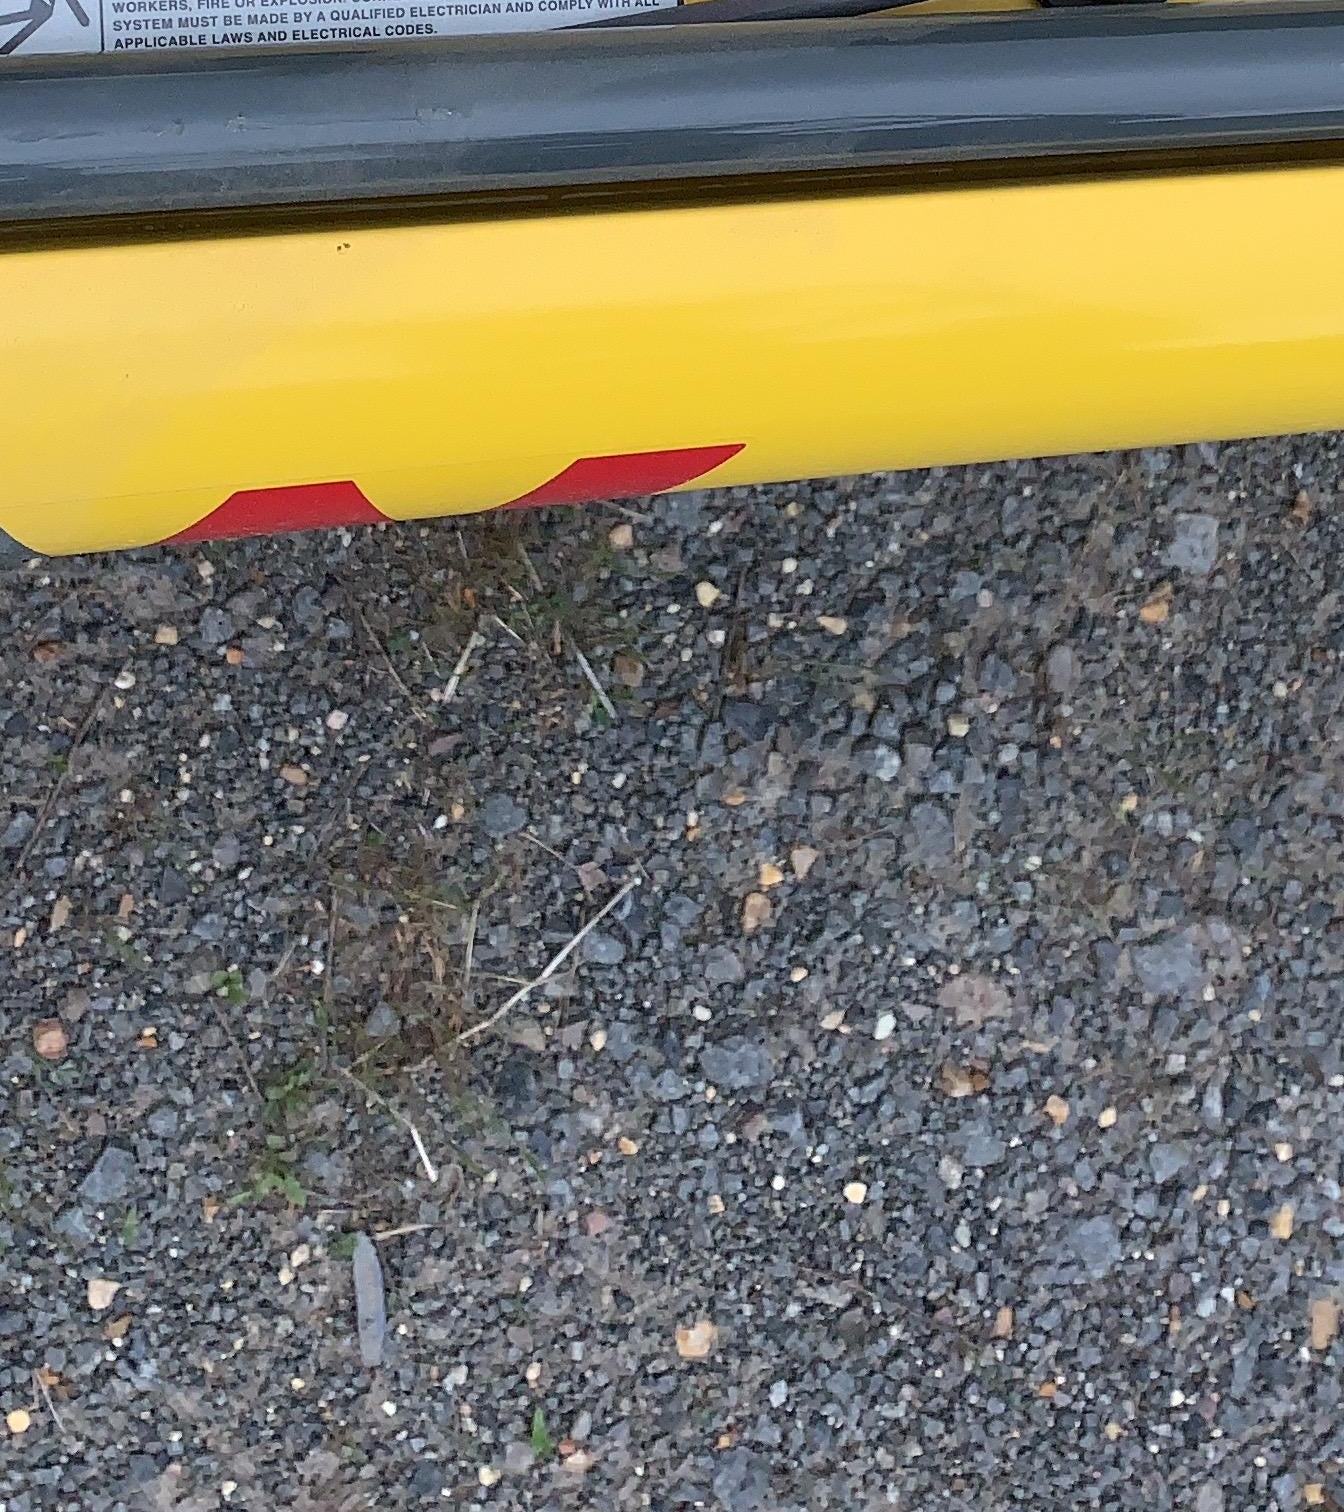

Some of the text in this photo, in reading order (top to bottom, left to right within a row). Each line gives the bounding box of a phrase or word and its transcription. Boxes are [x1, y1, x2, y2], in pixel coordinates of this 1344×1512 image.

[112, 0, 191, 14] WORKERS,
[112, 18, 172, 31] SYSTEM
[178, 16, 218, 28] MUST
[223, 15, 242, 26] BE
[247, 13, 288, 25] MADE
[293, 12, 311, 23] BY
[316, 11, 325, 22] A
[330, 8, 404, 22] QUALIFIED
[410, 3, 500, 18] ELECTRICIAN
[505, 2, 533, 14] AND
[538, 0, 592, 12] COMPLY
[114, 24, 437, 49] APPLICABLE LAWS AND ELECTRICAL CODES.
